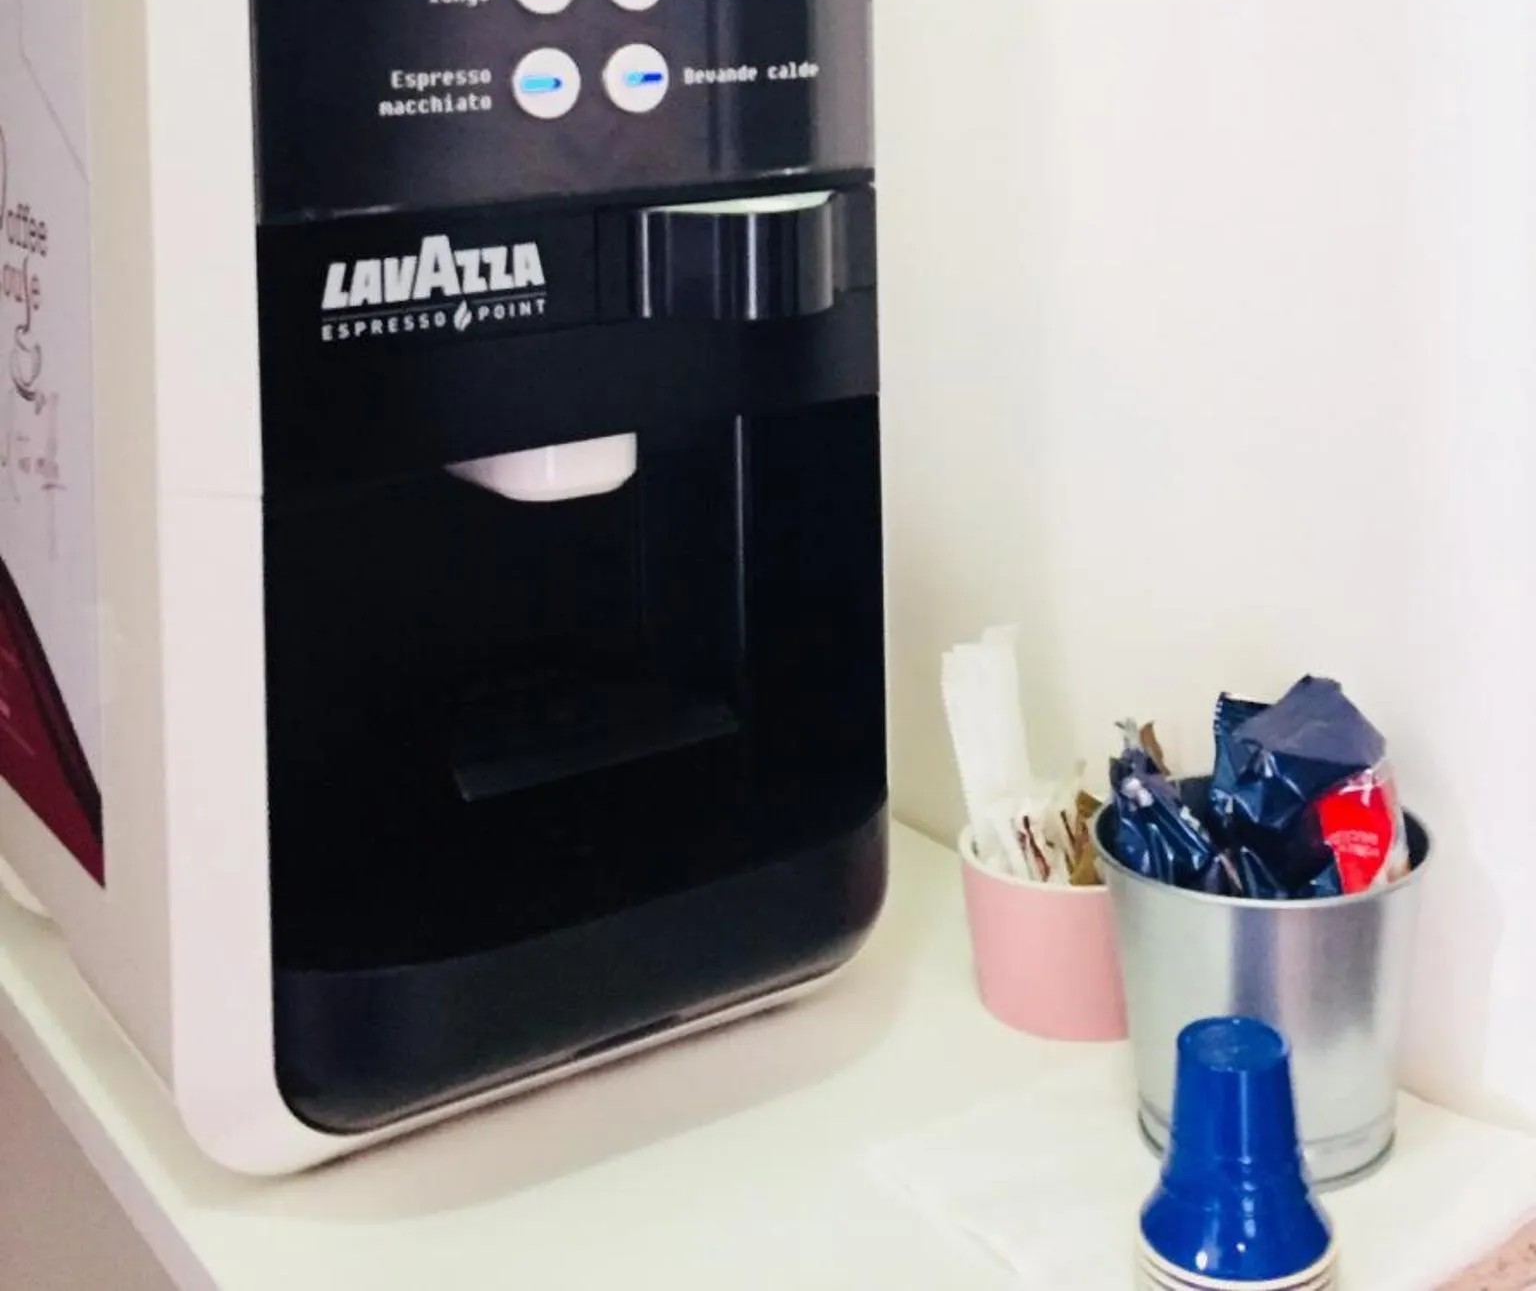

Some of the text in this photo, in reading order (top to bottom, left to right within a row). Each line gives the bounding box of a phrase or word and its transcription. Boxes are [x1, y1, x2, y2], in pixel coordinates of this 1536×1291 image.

[391, 69, 492, 92] Espresso
[683, 61, 820, 85] Bevande calde
[378, 93, 493, 117] macchiato
[321, 234, 547, 310] LAVAZZA
[321, 299, 547, 342] ESPRESSO POINT
